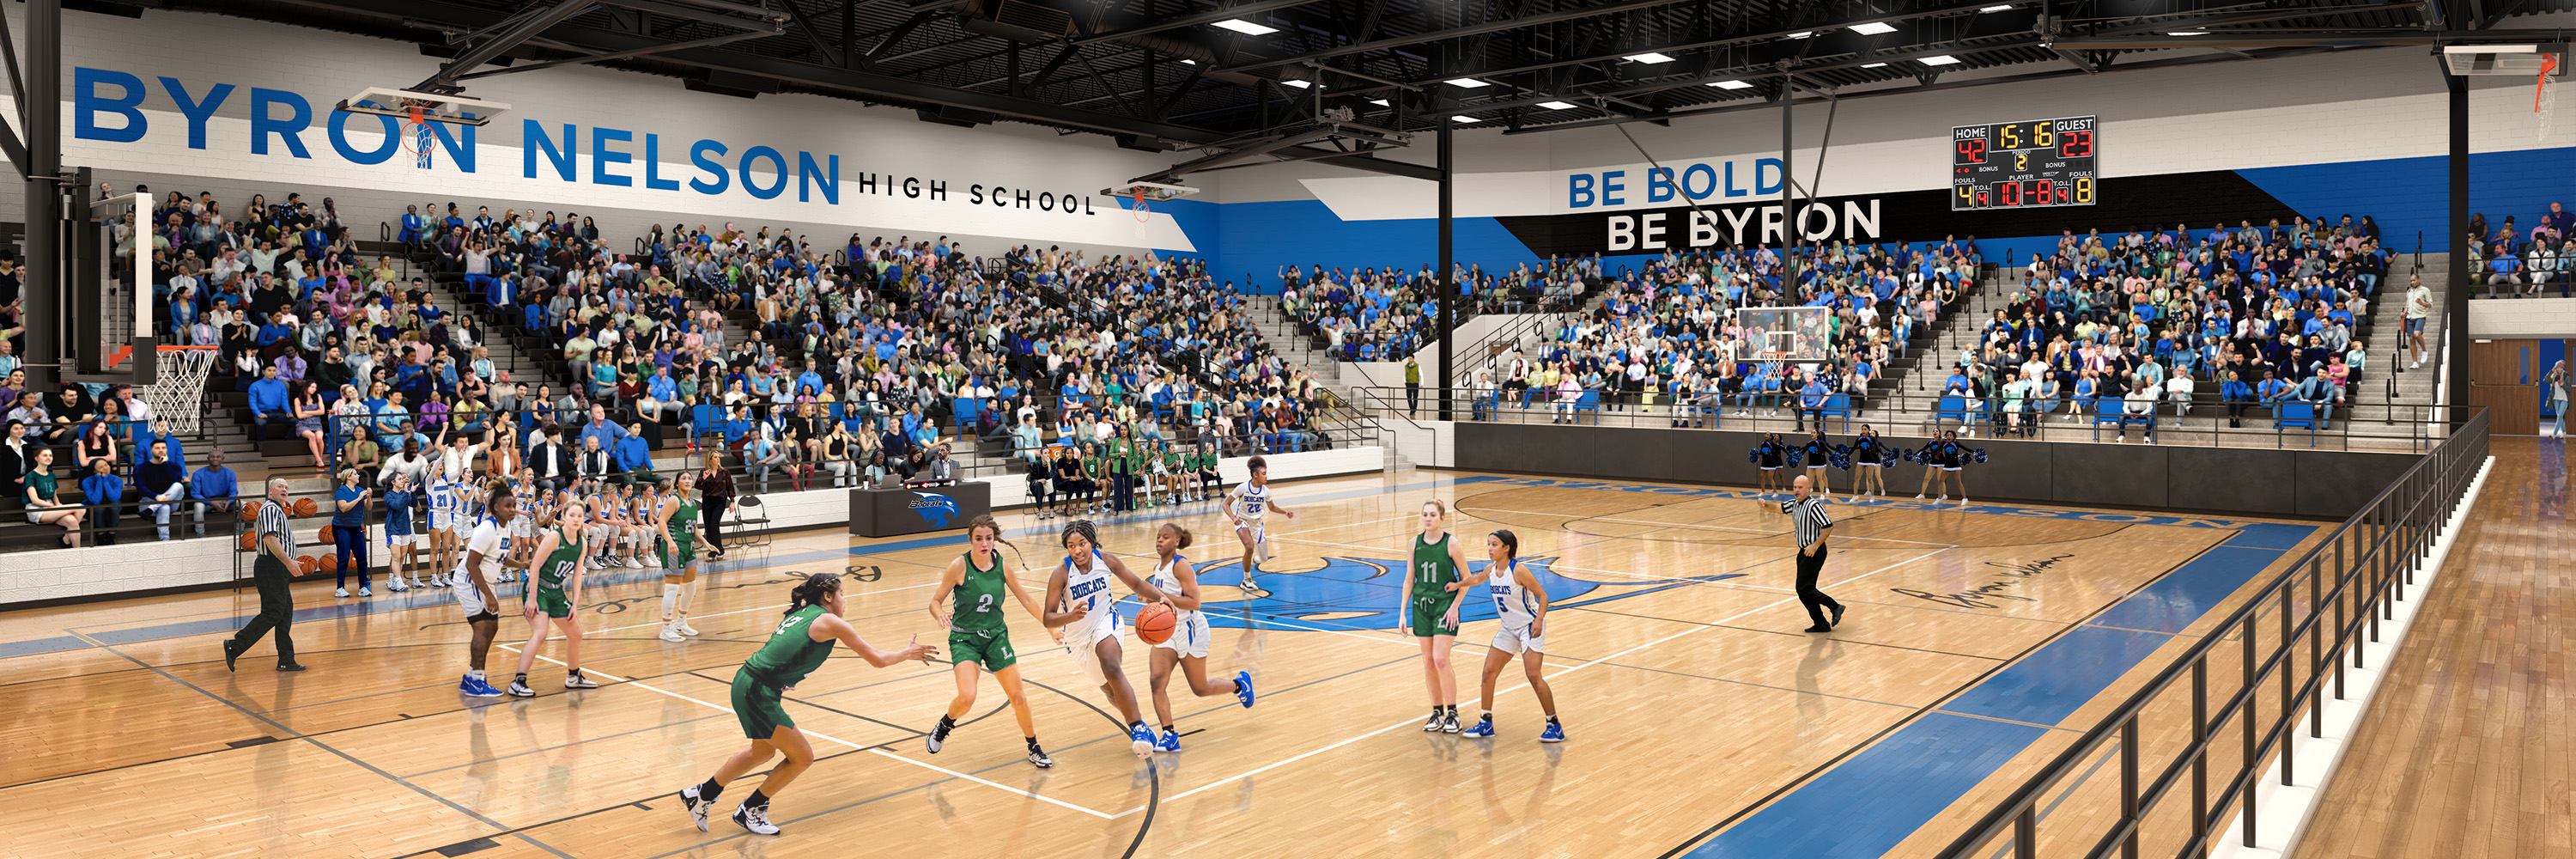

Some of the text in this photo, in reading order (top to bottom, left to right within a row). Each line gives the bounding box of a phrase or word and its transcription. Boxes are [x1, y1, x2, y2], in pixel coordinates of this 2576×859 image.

[1956, 128, 1986, 139] HOME
[2057, 119, 2093, 131] GUEST
[75, 67, 839, 205] BYRON NELSON
[2001, 122, 2053, 149] 15:16
[2063, 131, 2093, 156] 23
[1959, 139, 1985, 162] 42
[2017, 155, 2026, 170] 2
[1569, 157, 1784, 209] BE BOLD
[2076, 178, 2092, 203] 8
[859, 172, 1095, 216] HIGH SCHOOL
[1959, 186, 1972, 206] 4
[1978, 192, 1987, 205] 4
[2057, 188, 2068, 202] 4
[1607, 198, 1880, 252] BE BYRON
[1090, 464, 1095, 472] 8
[436, 494, 447, 507] 21
[1421, 561, 1437, 583] 11
[1070, 576, 1107, 600] BOBCATS
[1490, 585, 1511, 595] BOBCATS
[976, 594, 993, 612] 2
[1497, 596, 1509, 613] 5
[1000, 646, 1013, 661] L
